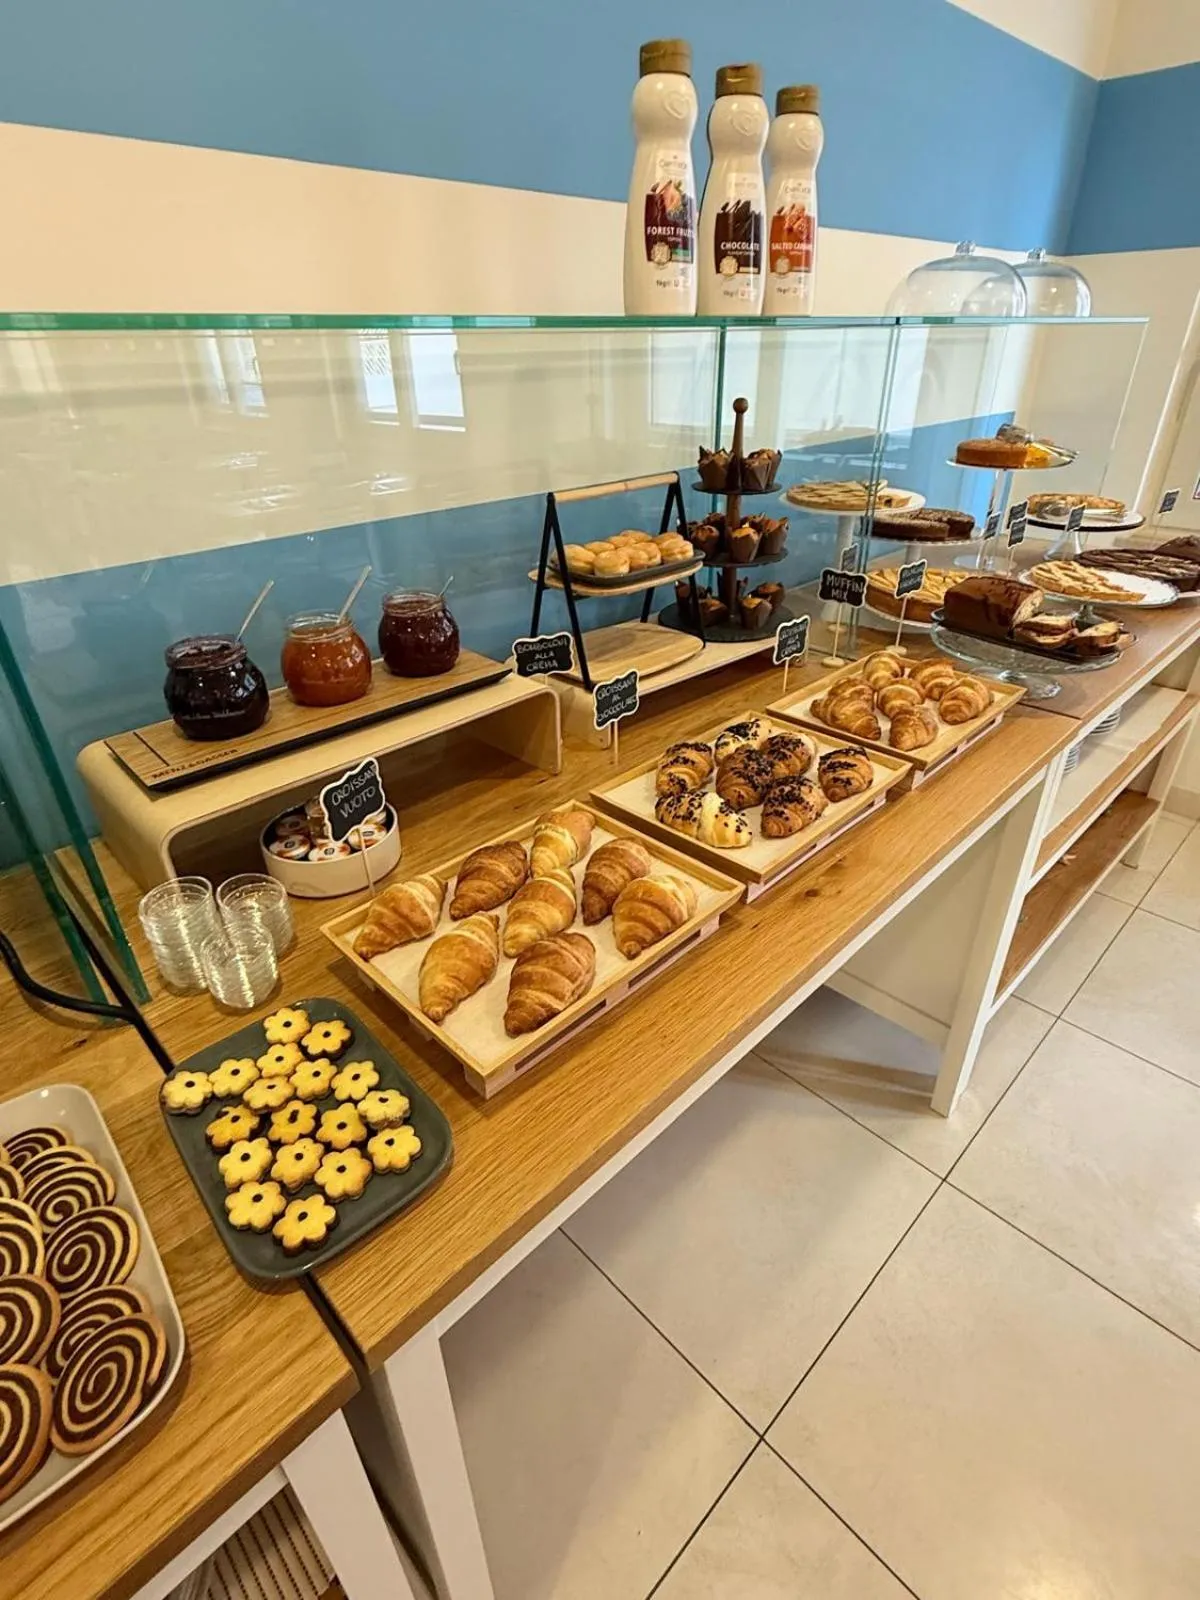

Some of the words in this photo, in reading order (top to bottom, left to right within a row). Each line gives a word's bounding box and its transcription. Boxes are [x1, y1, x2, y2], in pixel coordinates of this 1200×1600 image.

[647, 226, 675, 236] FOREST
[720, 242, 760, 251] CHOCOLATE
[831, 589, 848, 600] MIX
[534, 651, 555, 660] ALLA
[526, 660, 559, 672] CREMA
[597, 673, 636, 699] CROISSANT
[331, 764, 378, 806] CROISSANT
[340, 785, 376, 818] VUOTO
